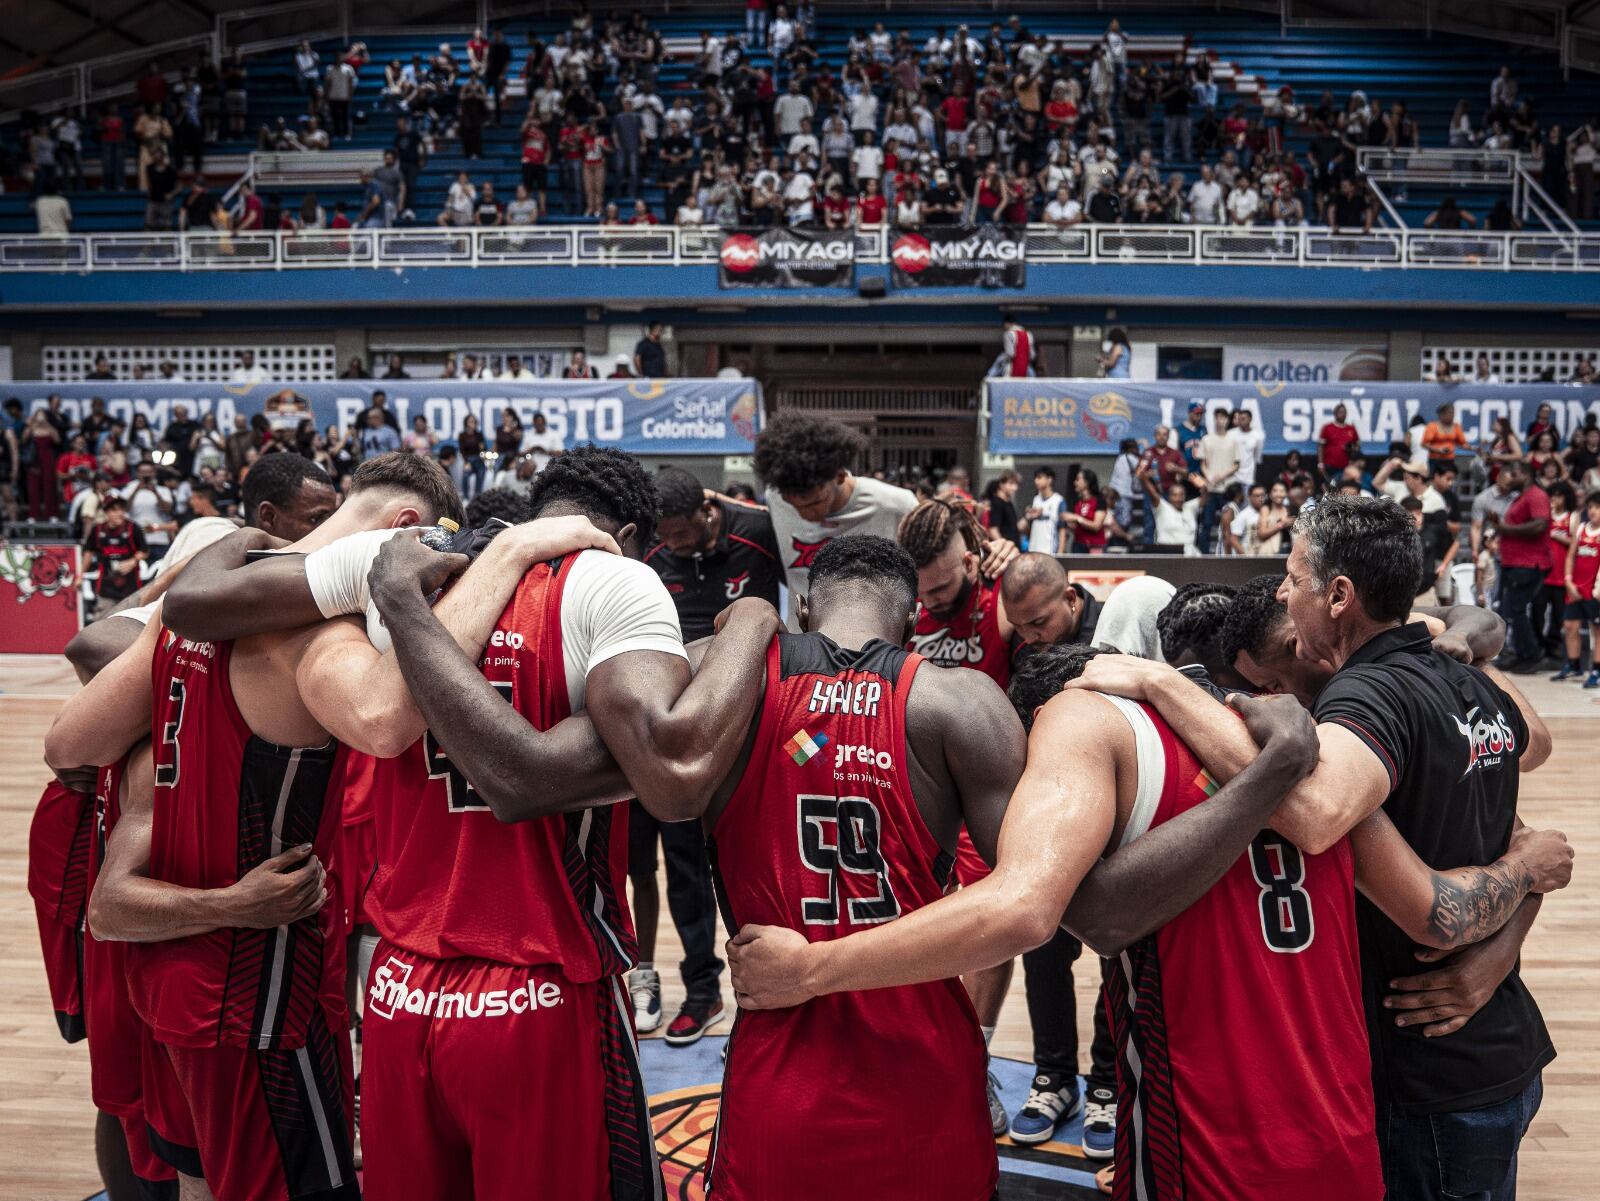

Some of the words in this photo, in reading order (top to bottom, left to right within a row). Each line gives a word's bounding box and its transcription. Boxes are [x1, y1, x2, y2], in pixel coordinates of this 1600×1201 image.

[759, 240, 854, 260] MIYAGI
[930, 236, 1025, 260] MIYAGI
[1233, 359, 1328, 383] molten
[336, 397, 624, 441] BLONCESTO
[673, 396, 727, 419] Señal
[1003, 398, 1078, 417] RADIO
[641, 417, 727, 440] Colombia
